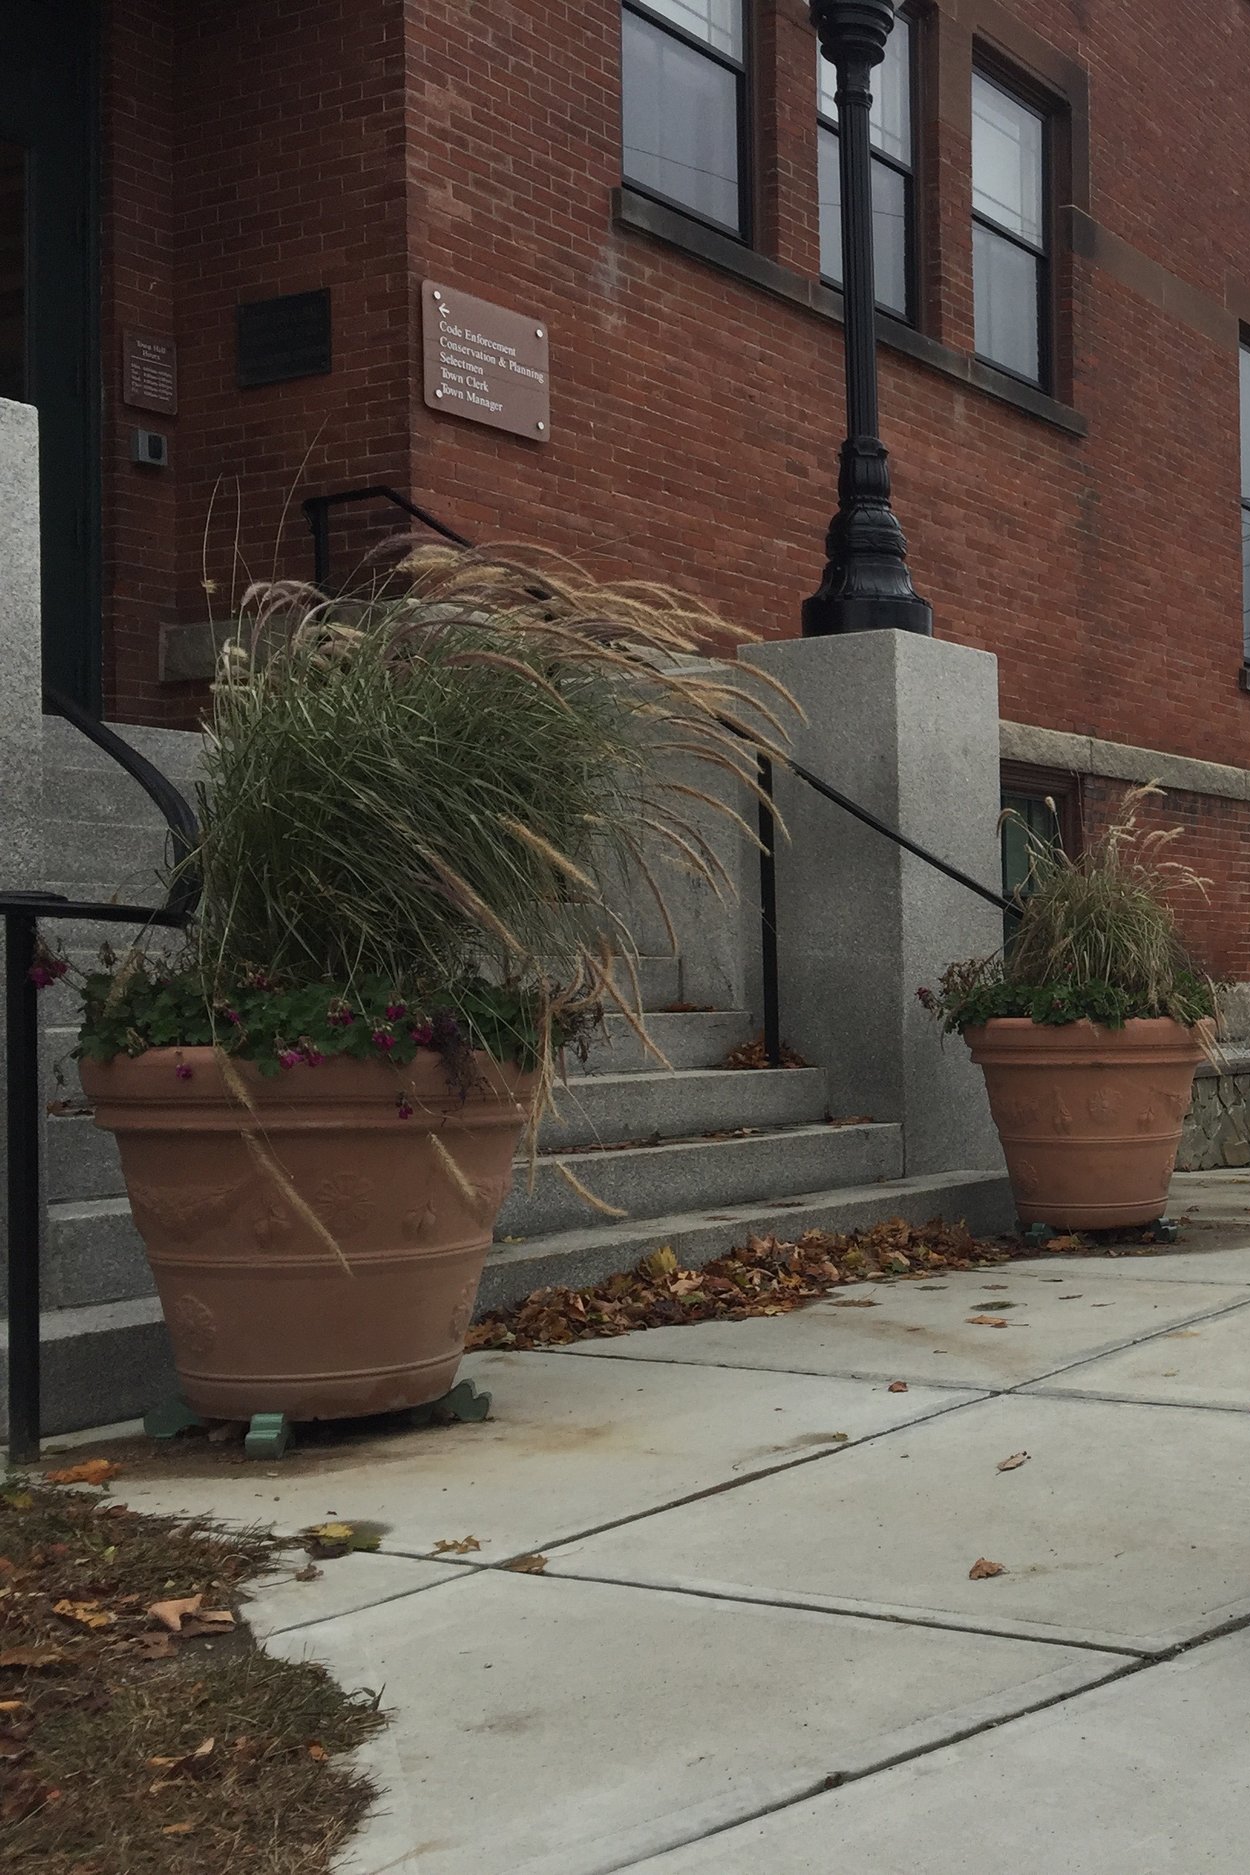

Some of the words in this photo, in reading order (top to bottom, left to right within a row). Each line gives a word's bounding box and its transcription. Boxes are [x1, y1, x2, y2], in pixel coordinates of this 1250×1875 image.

[439, 320, 462, 338] Code
[465, 329, 516, 357] Enforcement
[439, 336, 496, 365] Conservation
[498, 358, 506, 368] &
[509, 359, 545, 384] Planning
[439, 351, 484, 375] Selectmen
[440, 367, 463, 384] Town
[466, 375, 489, 392] Clerk
[440, 382, 464, 399] Town
[466, 391, 503, 412] Manager
